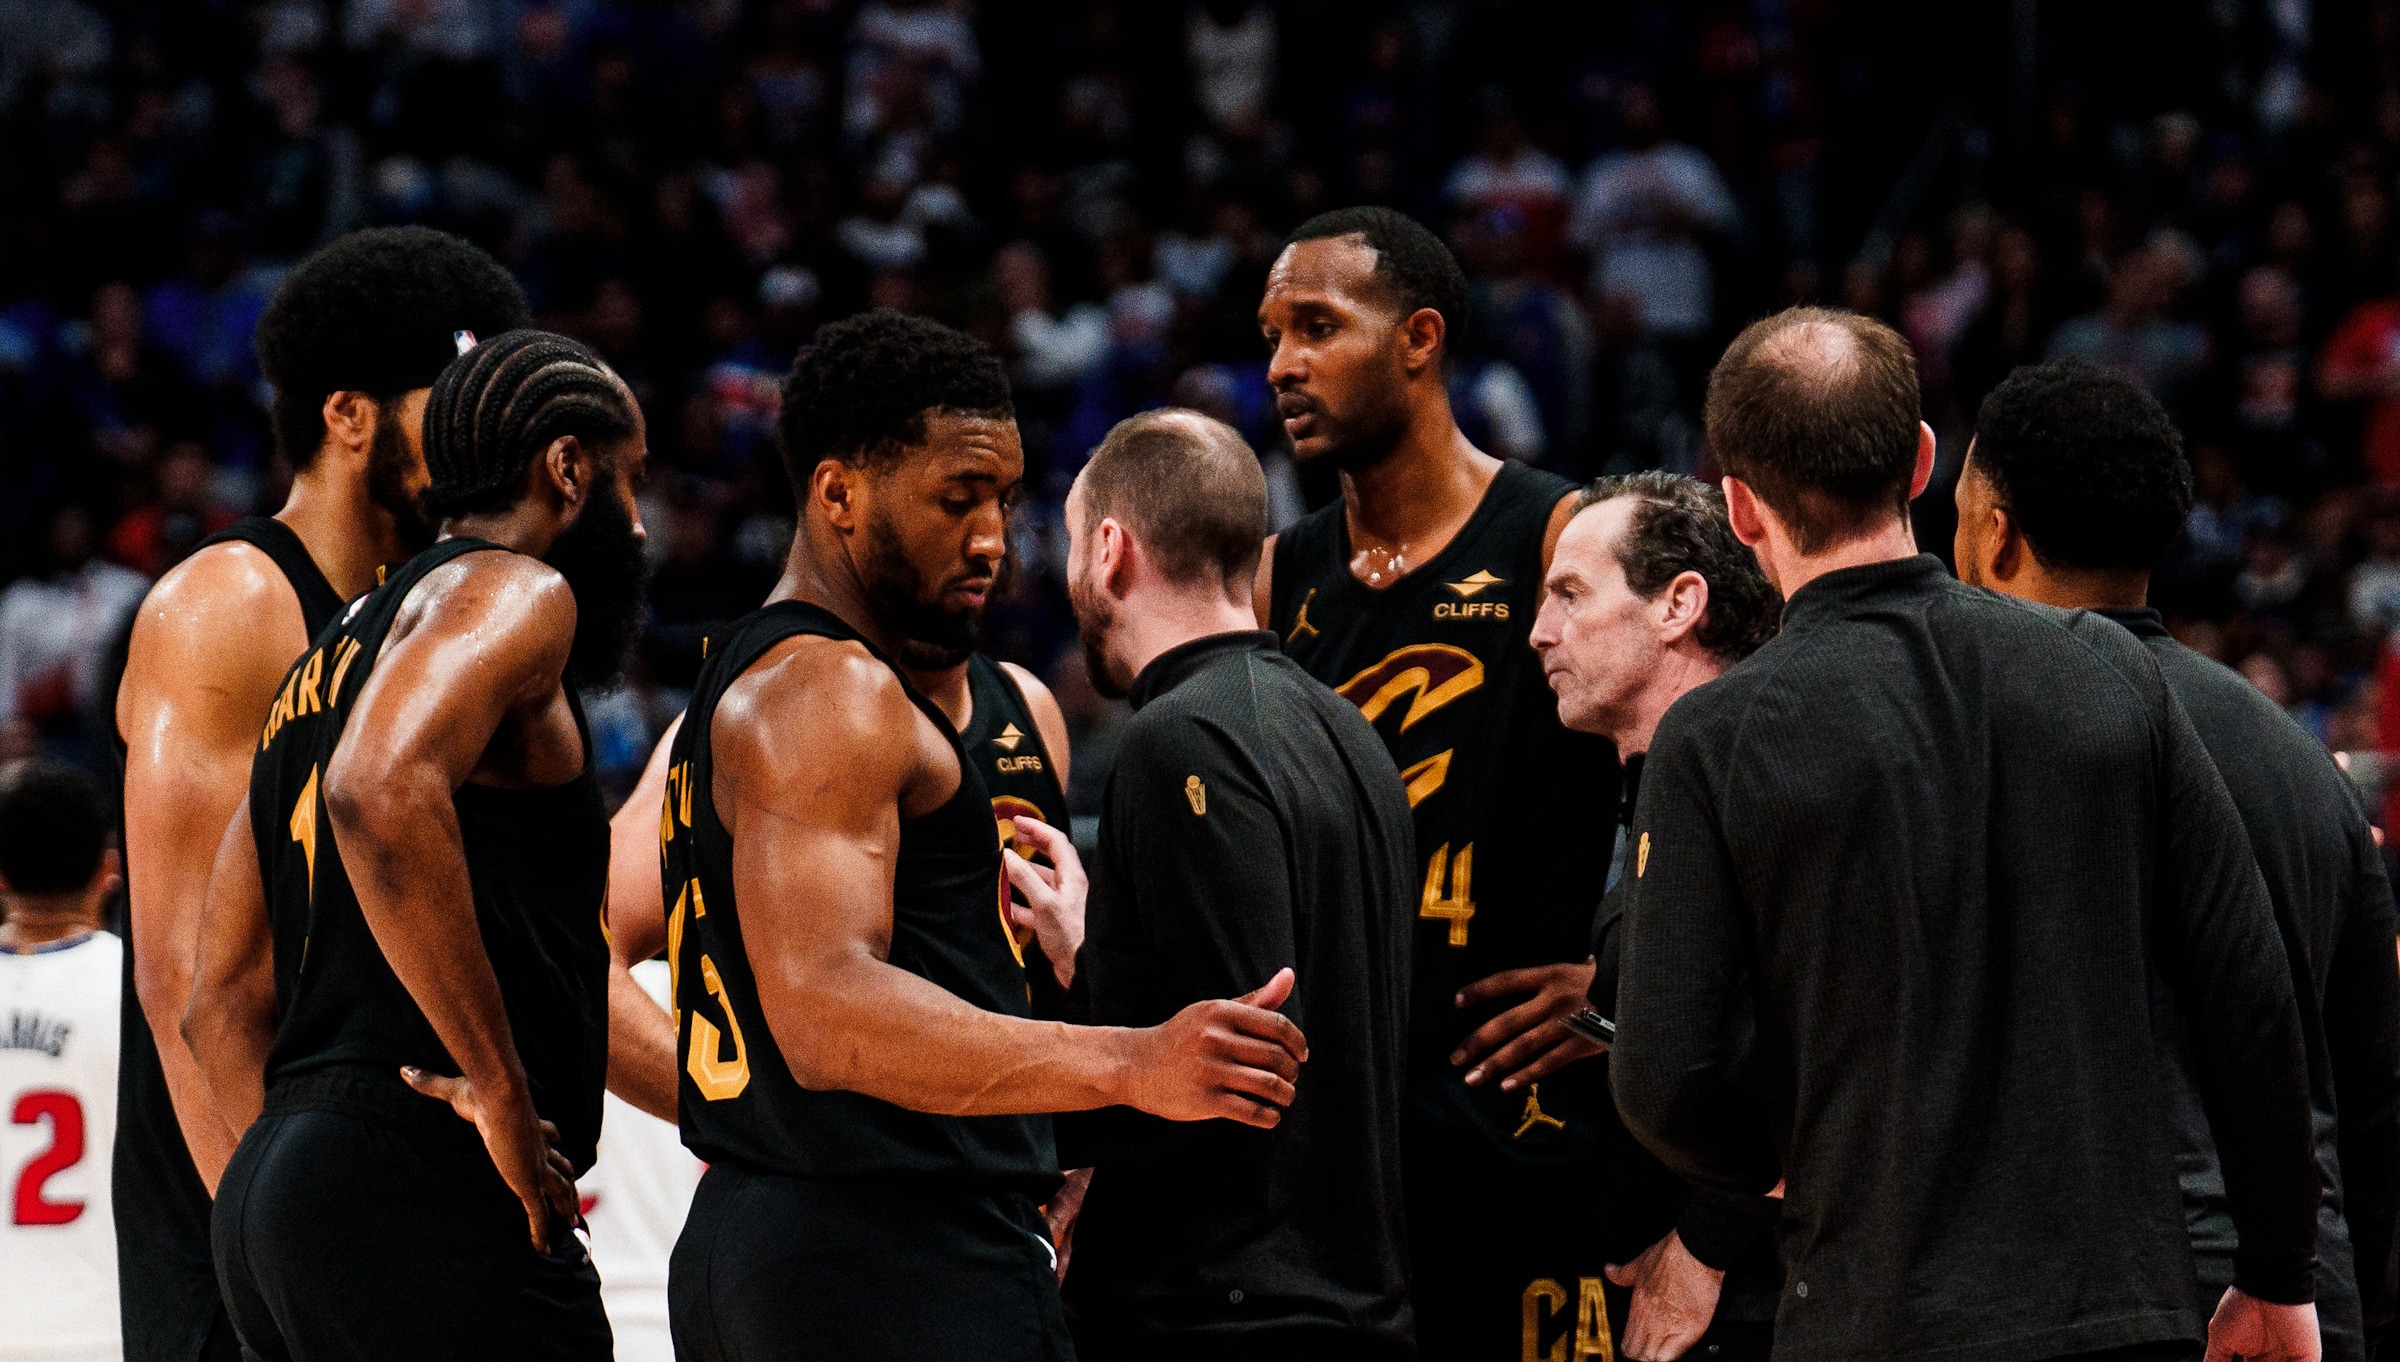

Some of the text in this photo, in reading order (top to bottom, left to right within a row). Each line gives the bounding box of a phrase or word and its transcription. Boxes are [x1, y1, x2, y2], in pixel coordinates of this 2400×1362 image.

[1433, 601, 1511, 620] CLIFFS
[996, 755, 1043, 773] CLIFFS
[1419, 840, 1477, 947] 4
